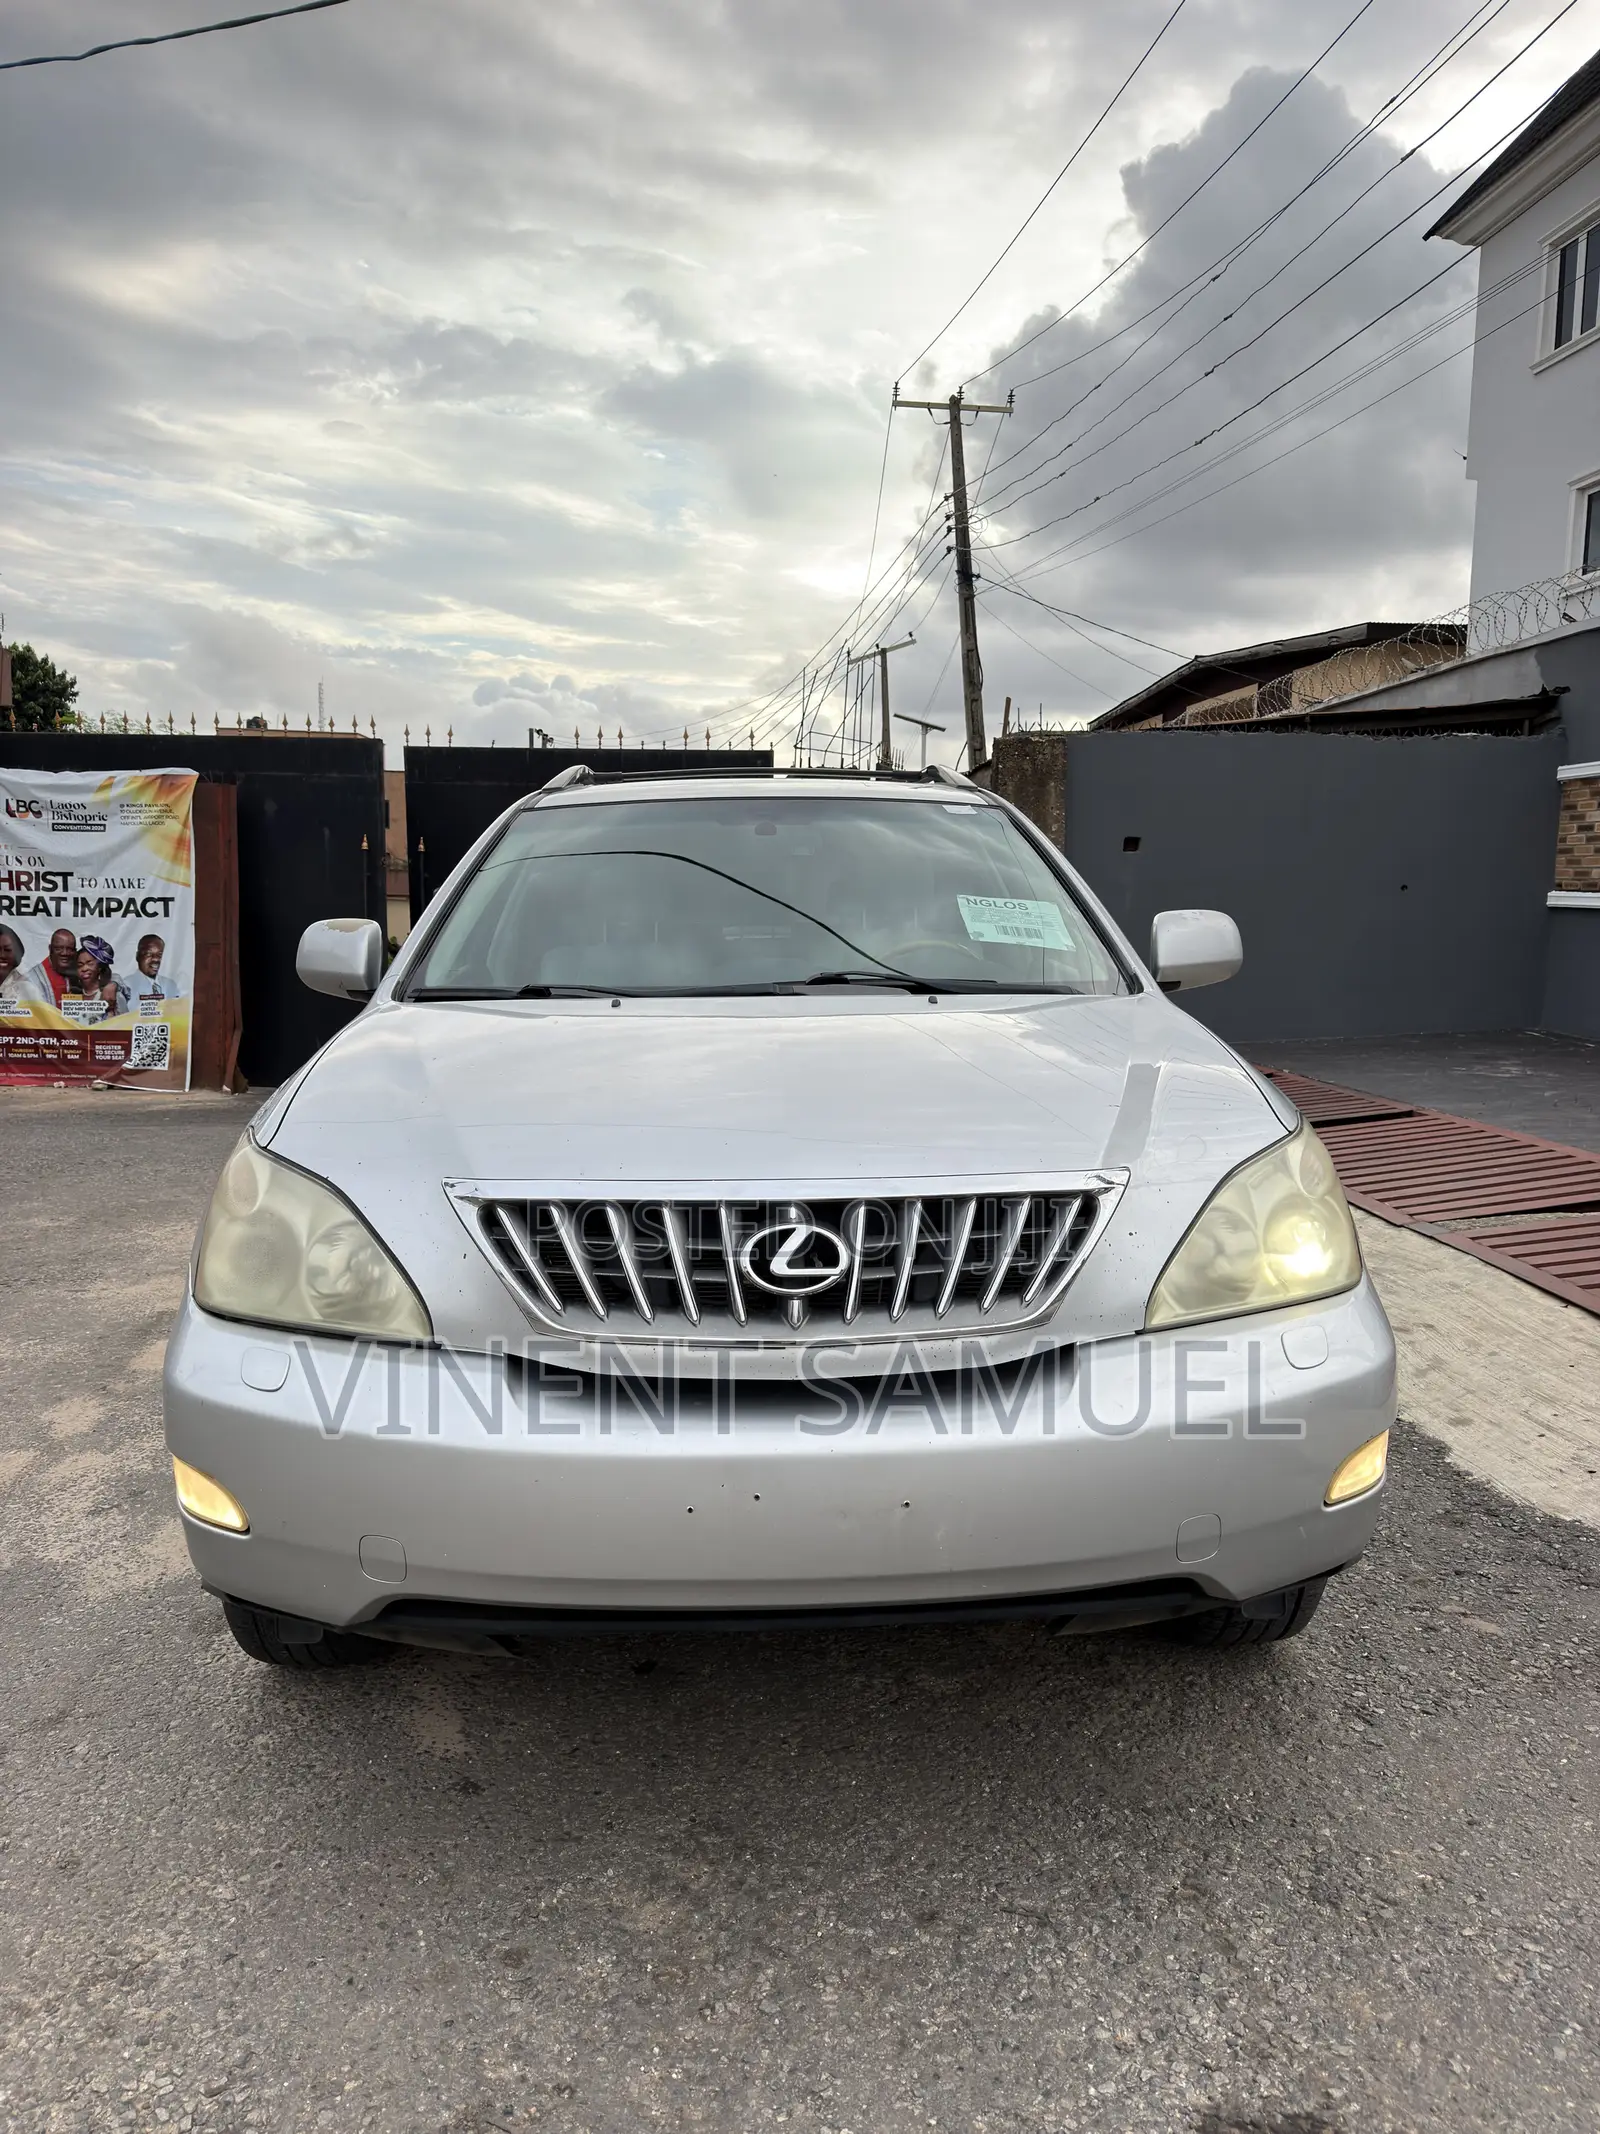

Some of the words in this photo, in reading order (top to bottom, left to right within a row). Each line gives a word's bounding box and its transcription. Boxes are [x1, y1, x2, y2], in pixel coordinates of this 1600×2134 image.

[50, 800, 87, 812] Lagos
[52, 810, 108, 823] Bishopric
[27, 855, 45, 867] ON
[77, 877, 98, 888] TO
[102, 878, 146, 889] MAKE
[73, 896, 175, 918] IMPACT
[966, 898, 1029, 911] NGLOS
